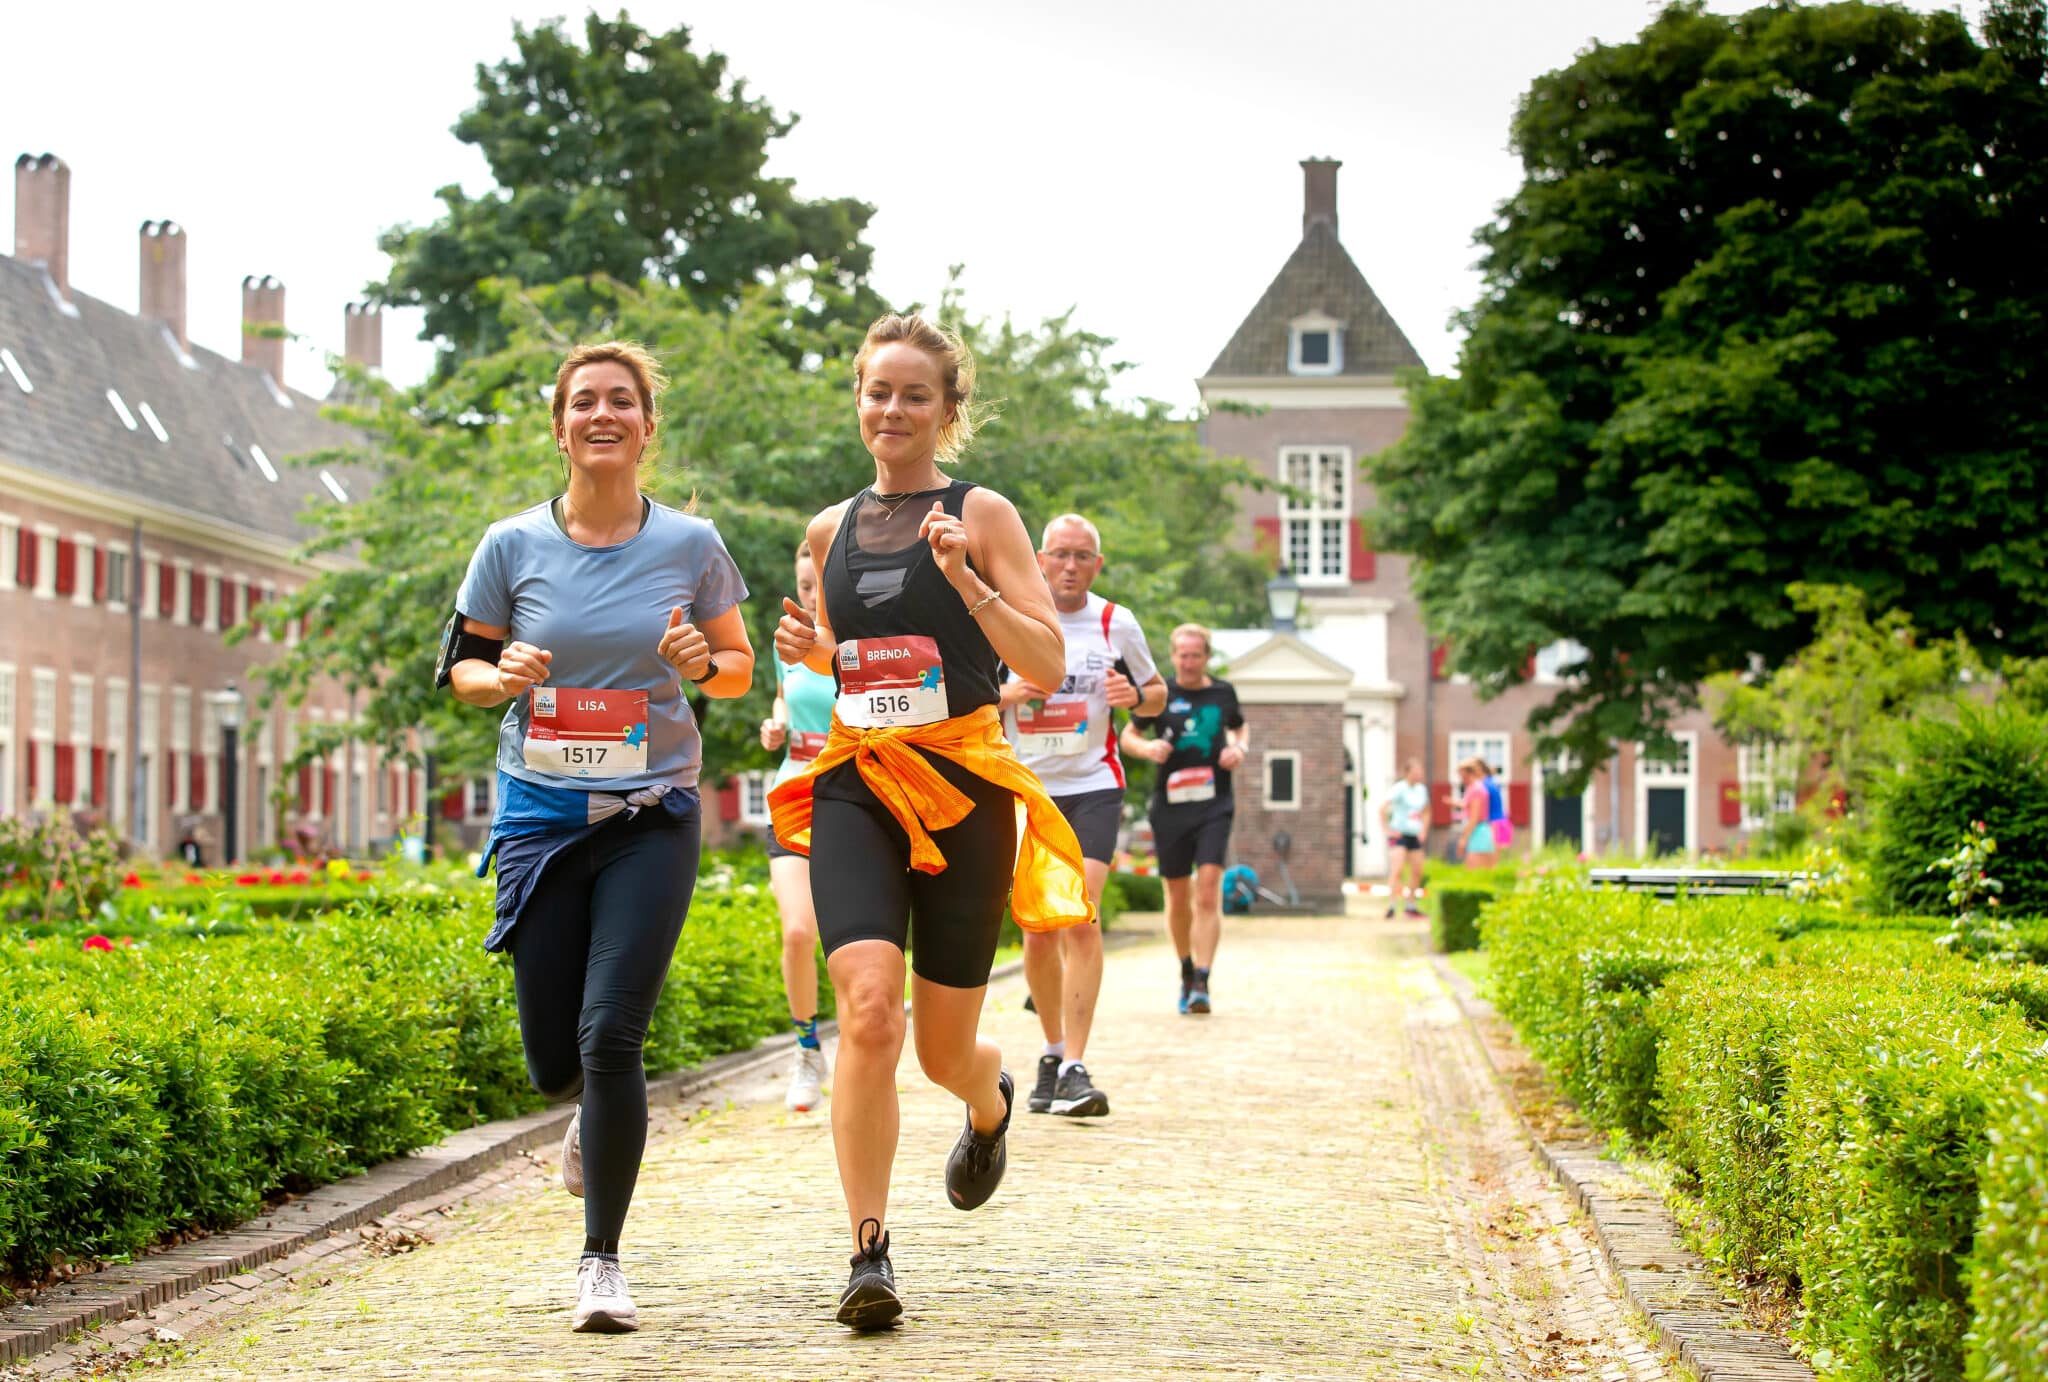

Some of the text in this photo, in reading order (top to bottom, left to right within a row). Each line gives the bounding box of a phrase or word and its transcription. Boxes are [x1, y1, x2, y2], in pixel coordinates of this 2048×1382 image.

[866, 648, 912, 661] BRENDA
[577, 700, 607, 712] LISA
[868, 695, 910, 714] 1516
[1042, 736, 1064, 747] 731
[561, 747, 608, 764] 1517
